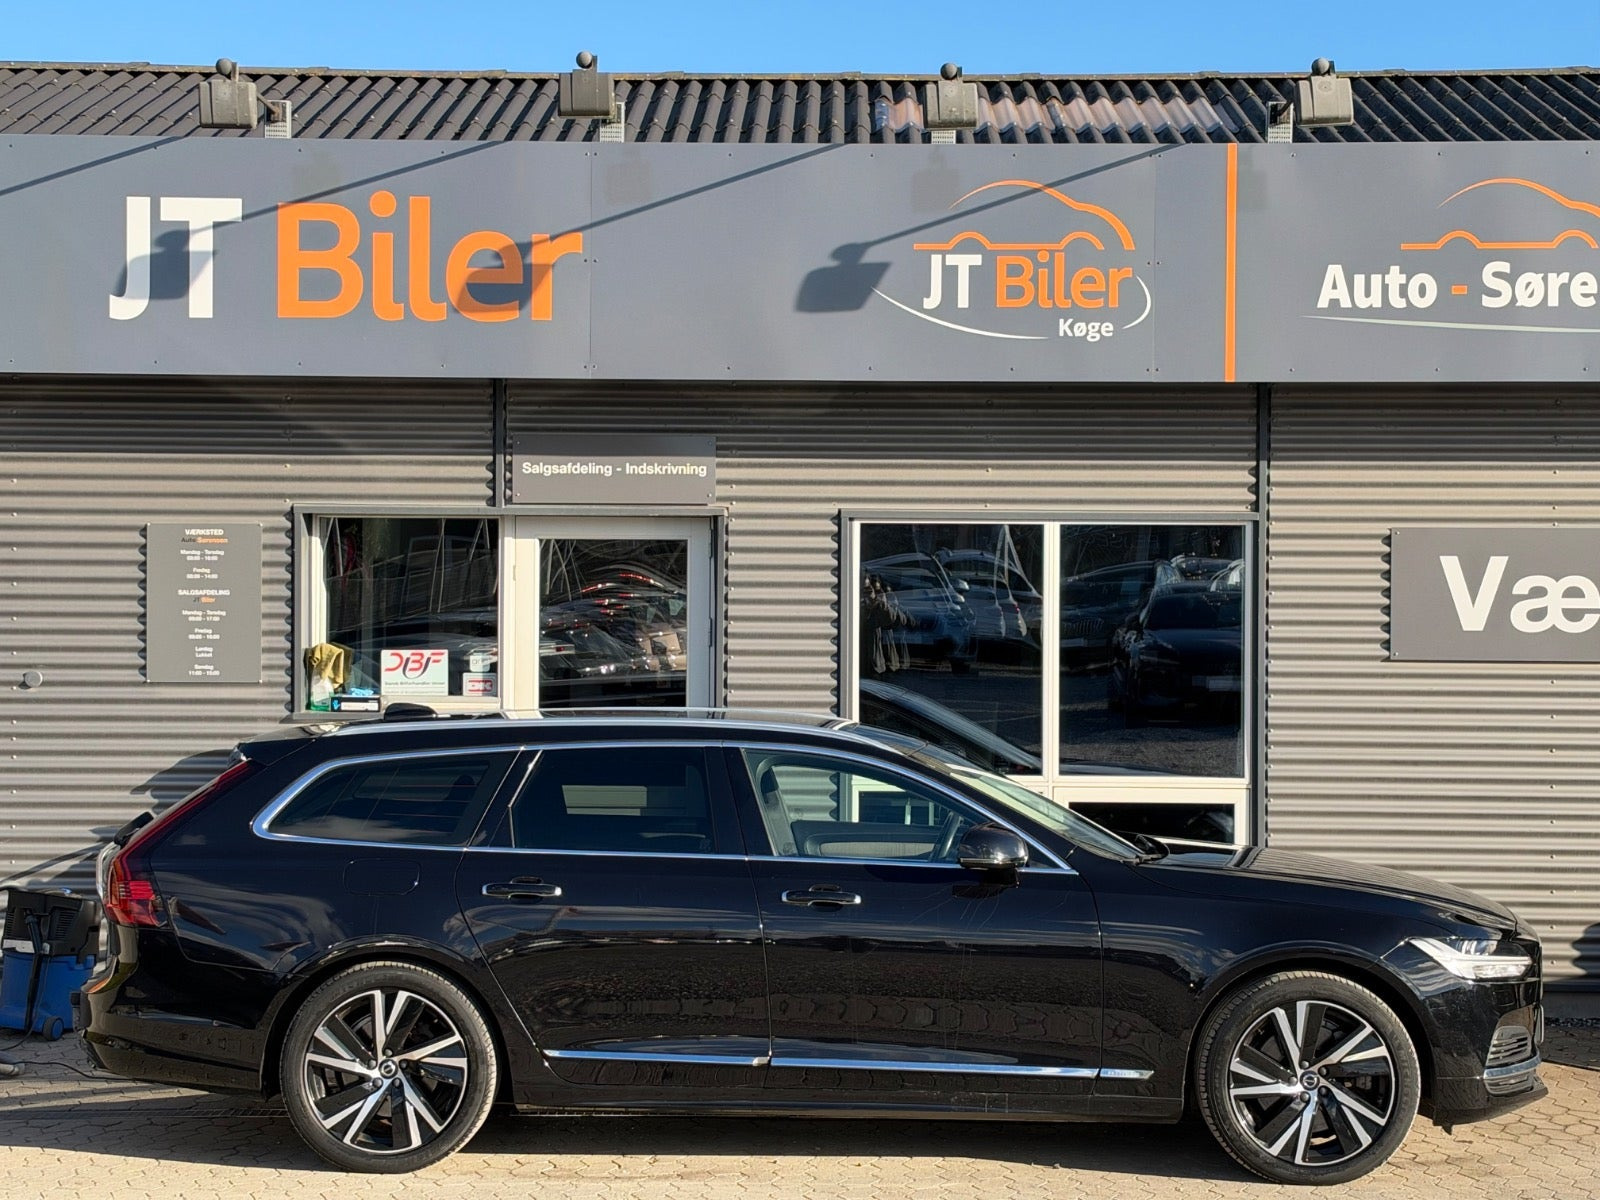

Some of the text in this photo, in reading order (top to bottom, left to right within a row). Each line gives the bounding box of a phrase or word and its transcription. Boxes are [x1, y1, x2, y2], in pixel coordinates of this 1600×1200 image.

[109, 190, 584, 322] JT Biler
[922, 249, 1133, 310] JT Biler
[1317, 264, 1438, 308] Auto
[1058, 318, 1114, 342] Køge
[521, 461, 614, 478] Salgsafdeling
[625, 462, 708, 478] Indskrivning
